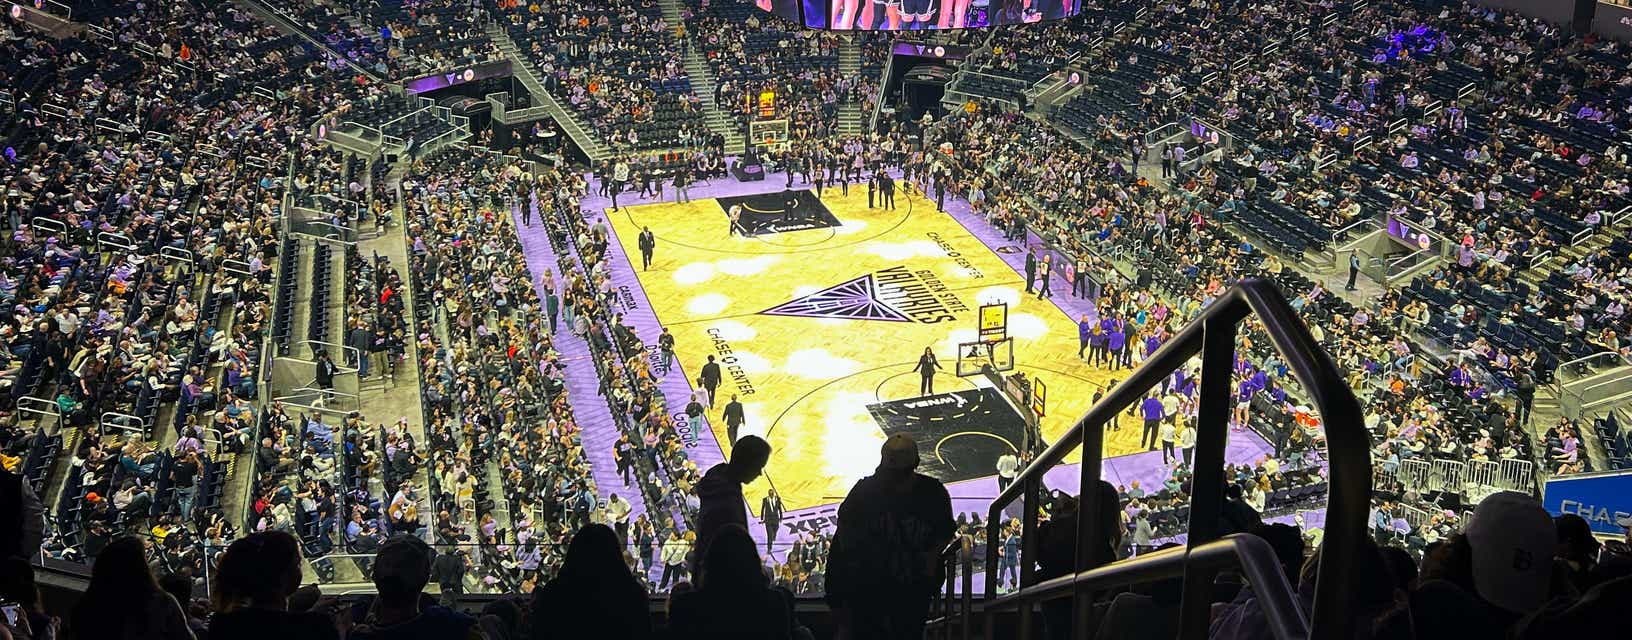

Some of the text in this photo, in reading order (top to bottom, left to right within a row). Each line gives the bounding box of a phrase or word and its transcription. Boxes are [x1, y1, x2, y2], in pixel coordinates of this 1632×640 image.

[876, 265, 957, 324] VALKYRIES
[915, 269, 970, 313] GOLDEN STATE
[707, 328, 756, 397] CHASE CENTER
[904, 397, 956, 409] WNBA
